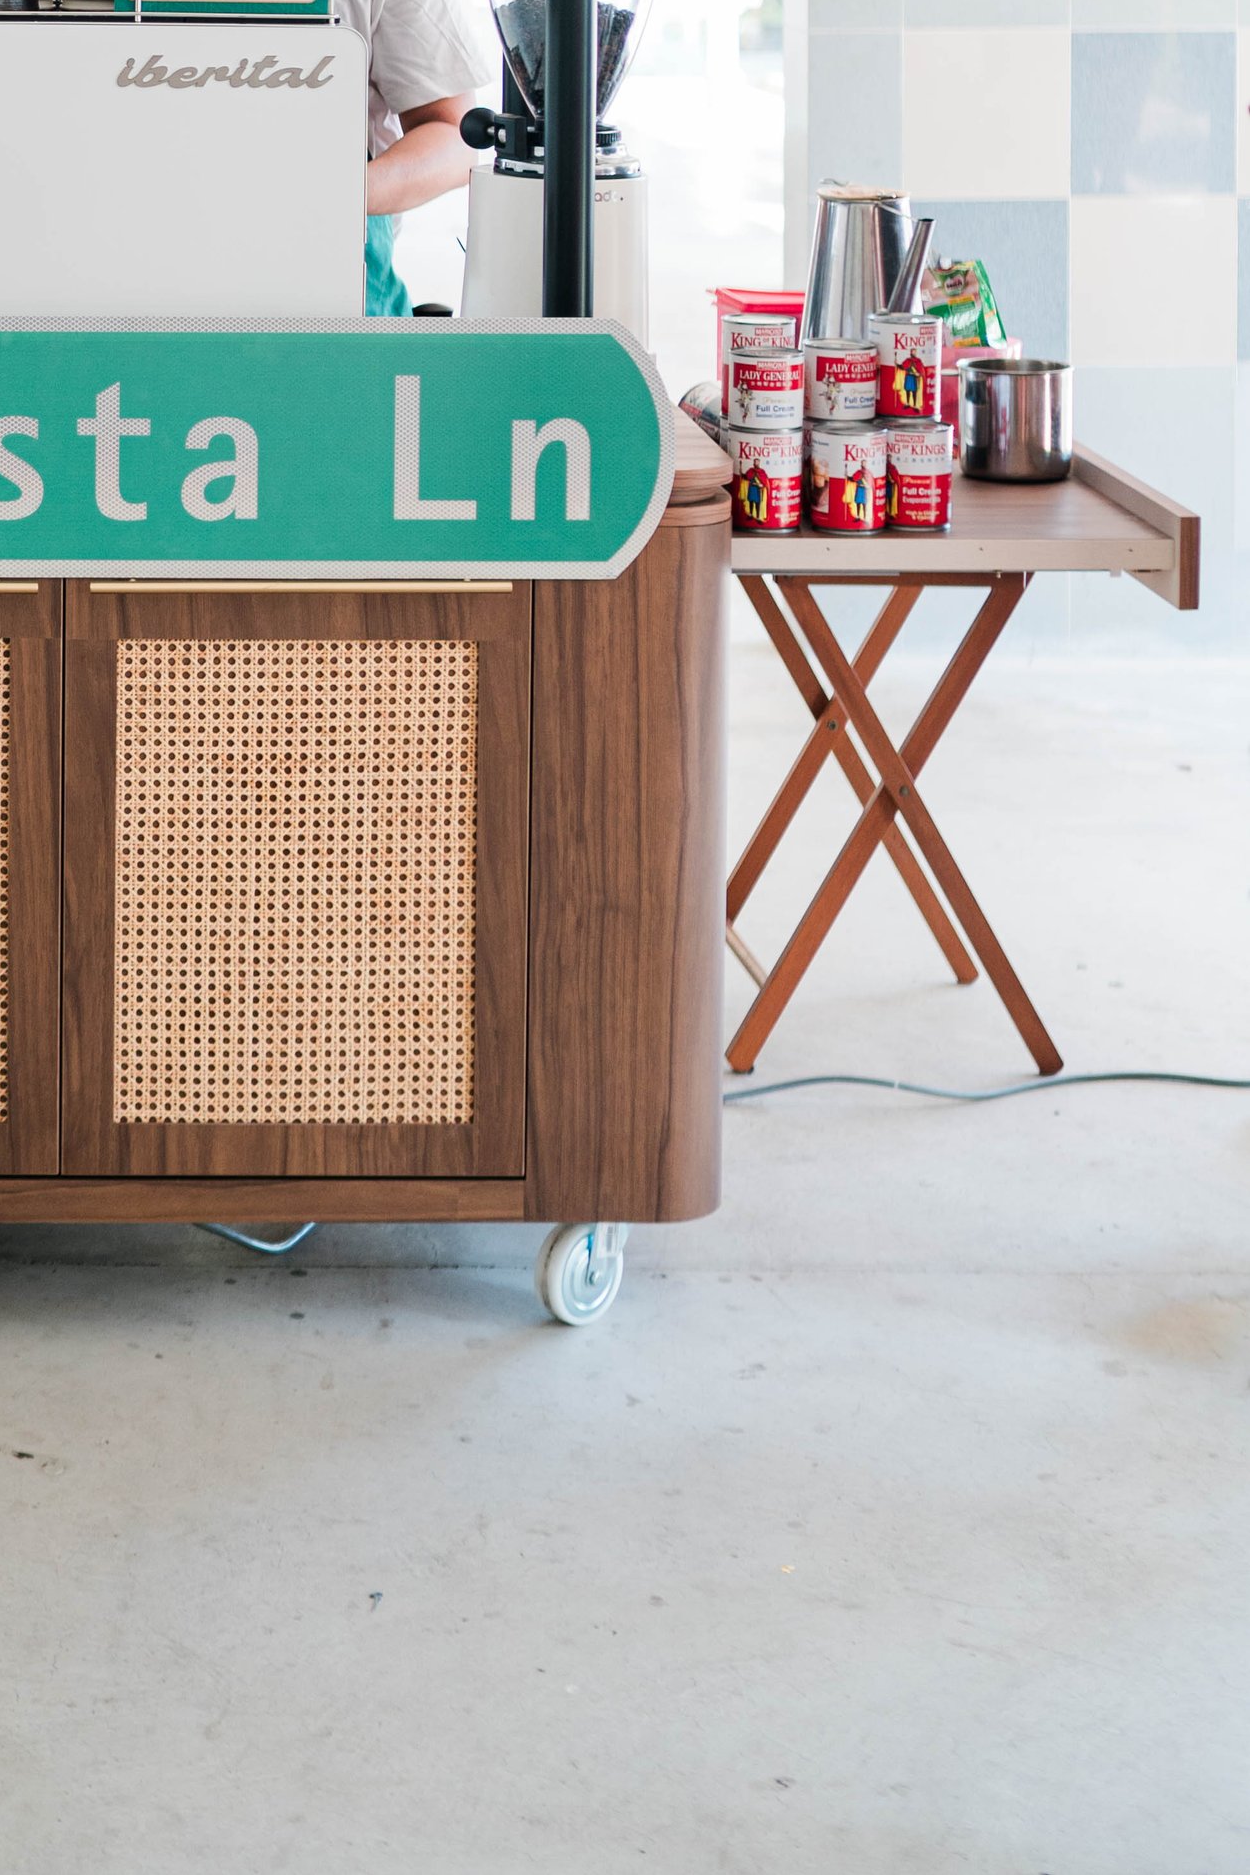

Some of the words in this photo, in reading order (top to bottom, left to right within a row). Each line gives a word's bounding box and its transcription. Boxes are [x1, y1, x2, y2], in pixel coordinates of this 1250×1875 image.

[116, 54, 336, 89] iberital
[731, 332, 762, 349] KING
[893, 332, 926, 350] KING
[739, 369, 762, 380] LADY
[763, 370, 799, 381] GENERAL
[826, 363, 850, 373] LADY
[756, 405, 771, 413] Full
[392, 372, 594, 522] Ln
[739, 441, 770, 460] KING
[844, 444, 876, 461] KING
[911, 444, 946, 455] KINGS
